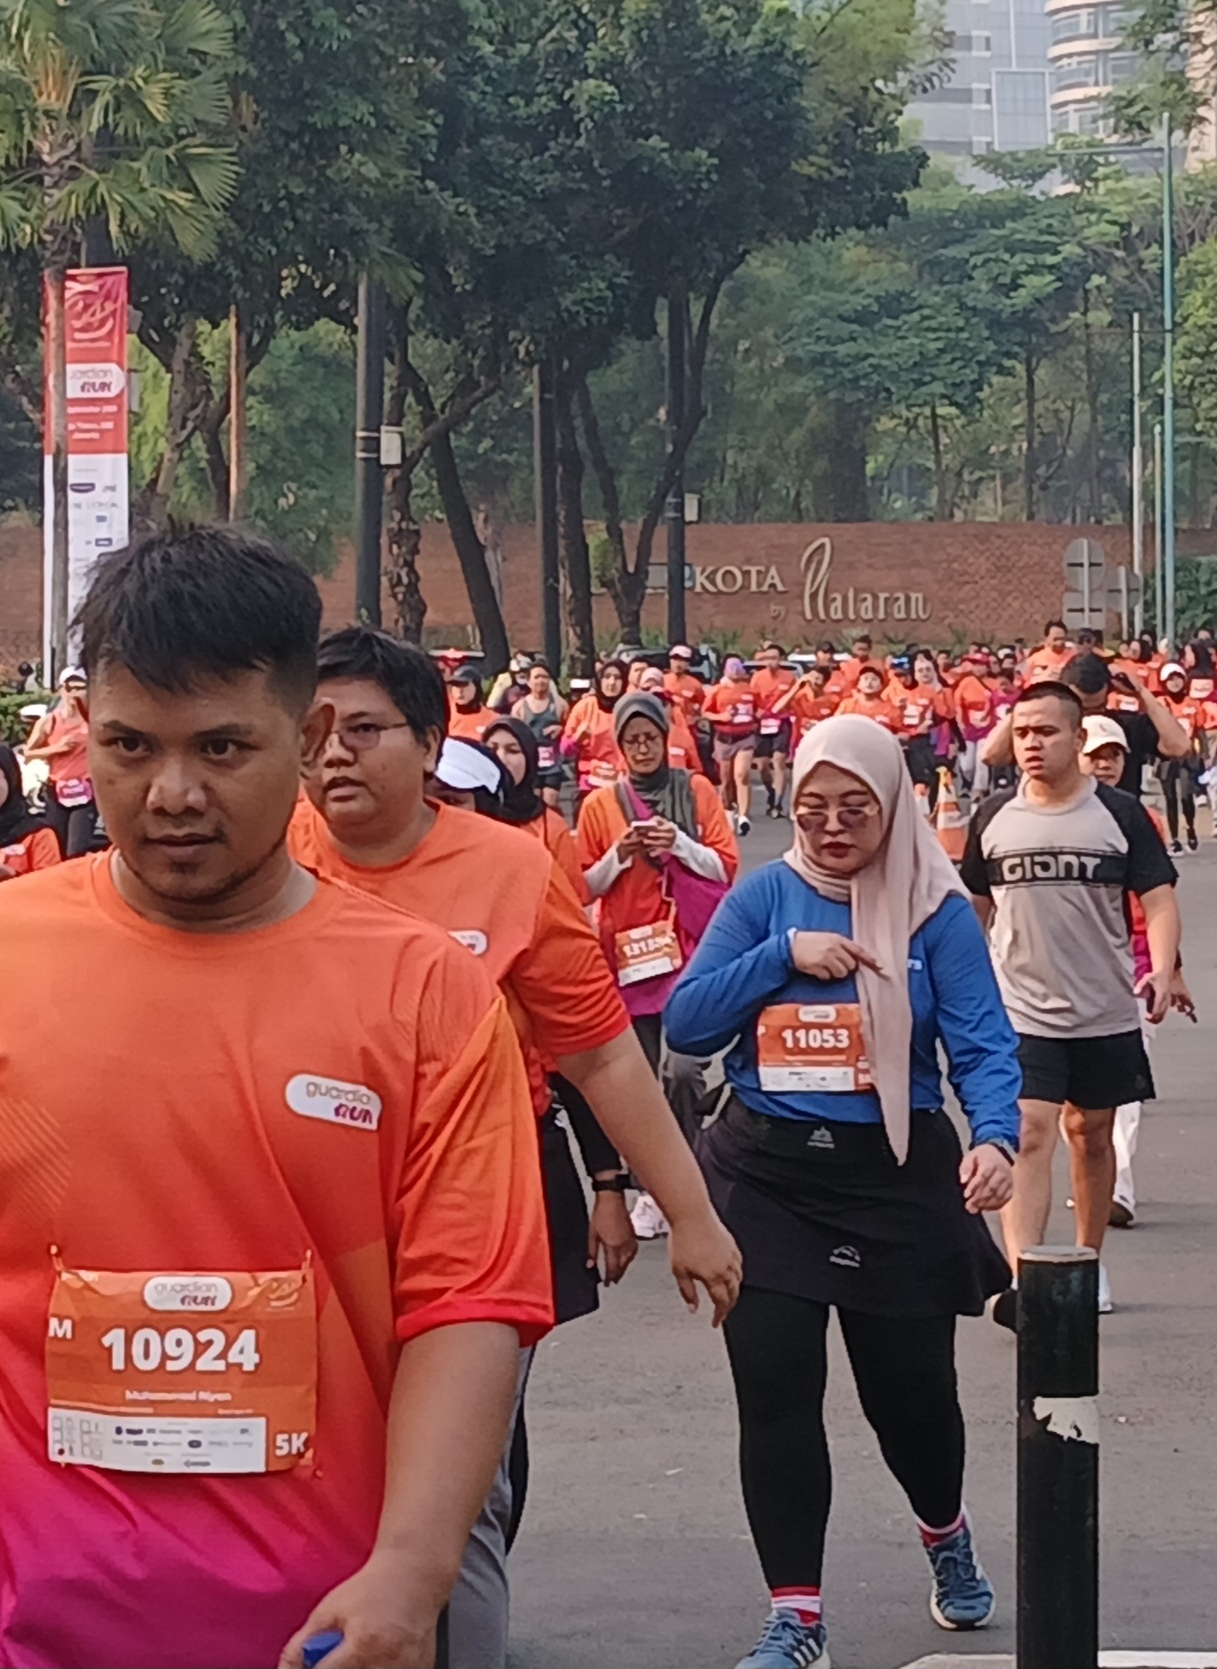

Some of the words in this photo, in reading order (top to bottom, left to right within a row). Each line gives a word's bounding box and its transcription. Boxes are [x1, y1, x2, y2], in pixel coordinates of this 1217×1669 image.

[694, 565, 786, 594] KOTA
[800, 537, 932, 620] Plataran
[1002, 855, 1101, 881] GIANT
[782, 1029, 850, 1048] 11053
[154, 1282, 218, 1295] guardian
[180, 1294, 217, 1306] RUN
[48, 1317, 72, 1339] M
[101, 1328, 260, 1371] 10924
[275, 1432, 309, 1456] 5K
